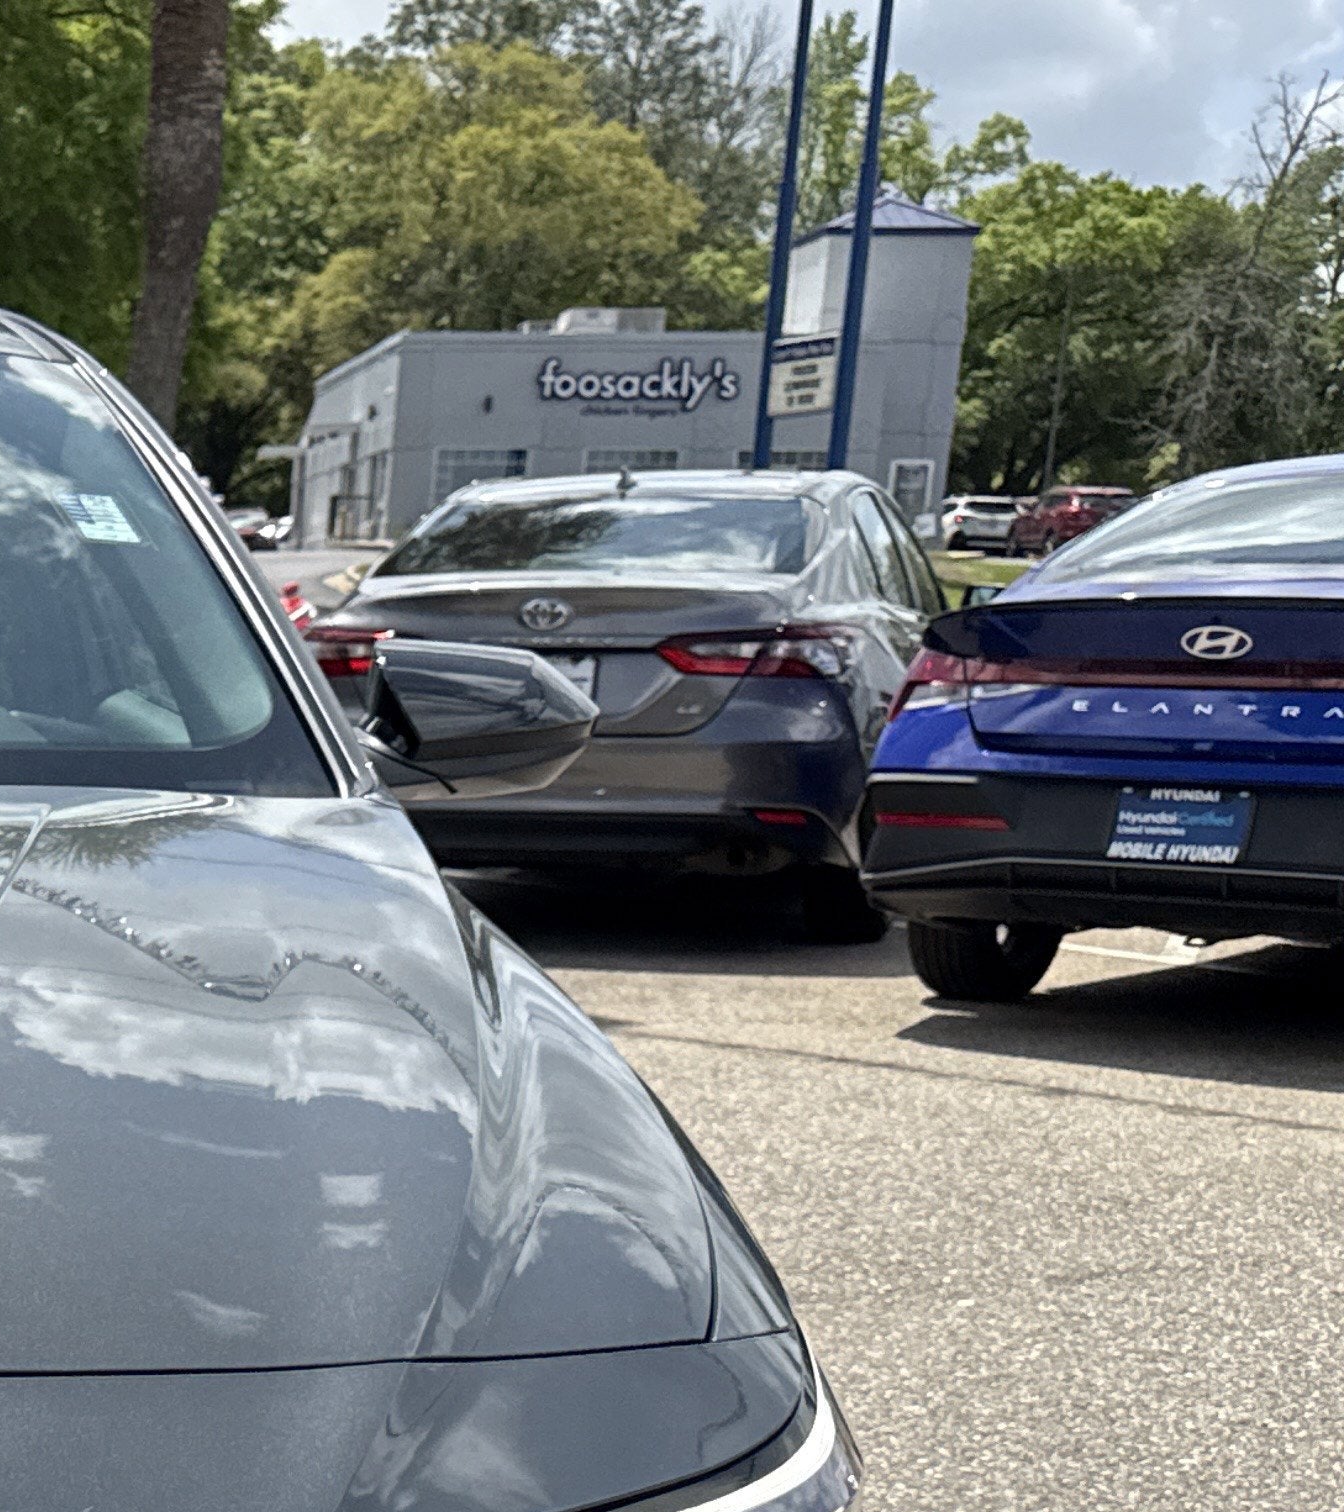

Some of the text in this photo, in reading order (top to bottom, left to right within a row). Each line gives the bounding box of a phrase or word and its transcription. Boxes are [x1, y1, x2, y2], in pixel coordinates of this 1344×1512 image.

[538, 357, 740, 412] foosackly's
[1071, 700, 1344, 719] ELANTRA
[1150, 788, 1221, 803] HYUNDAI
[1118, 810, 1178, 825] Hyundai
[1107, 841, 1240, 864] MOBILE HYUNDAI
